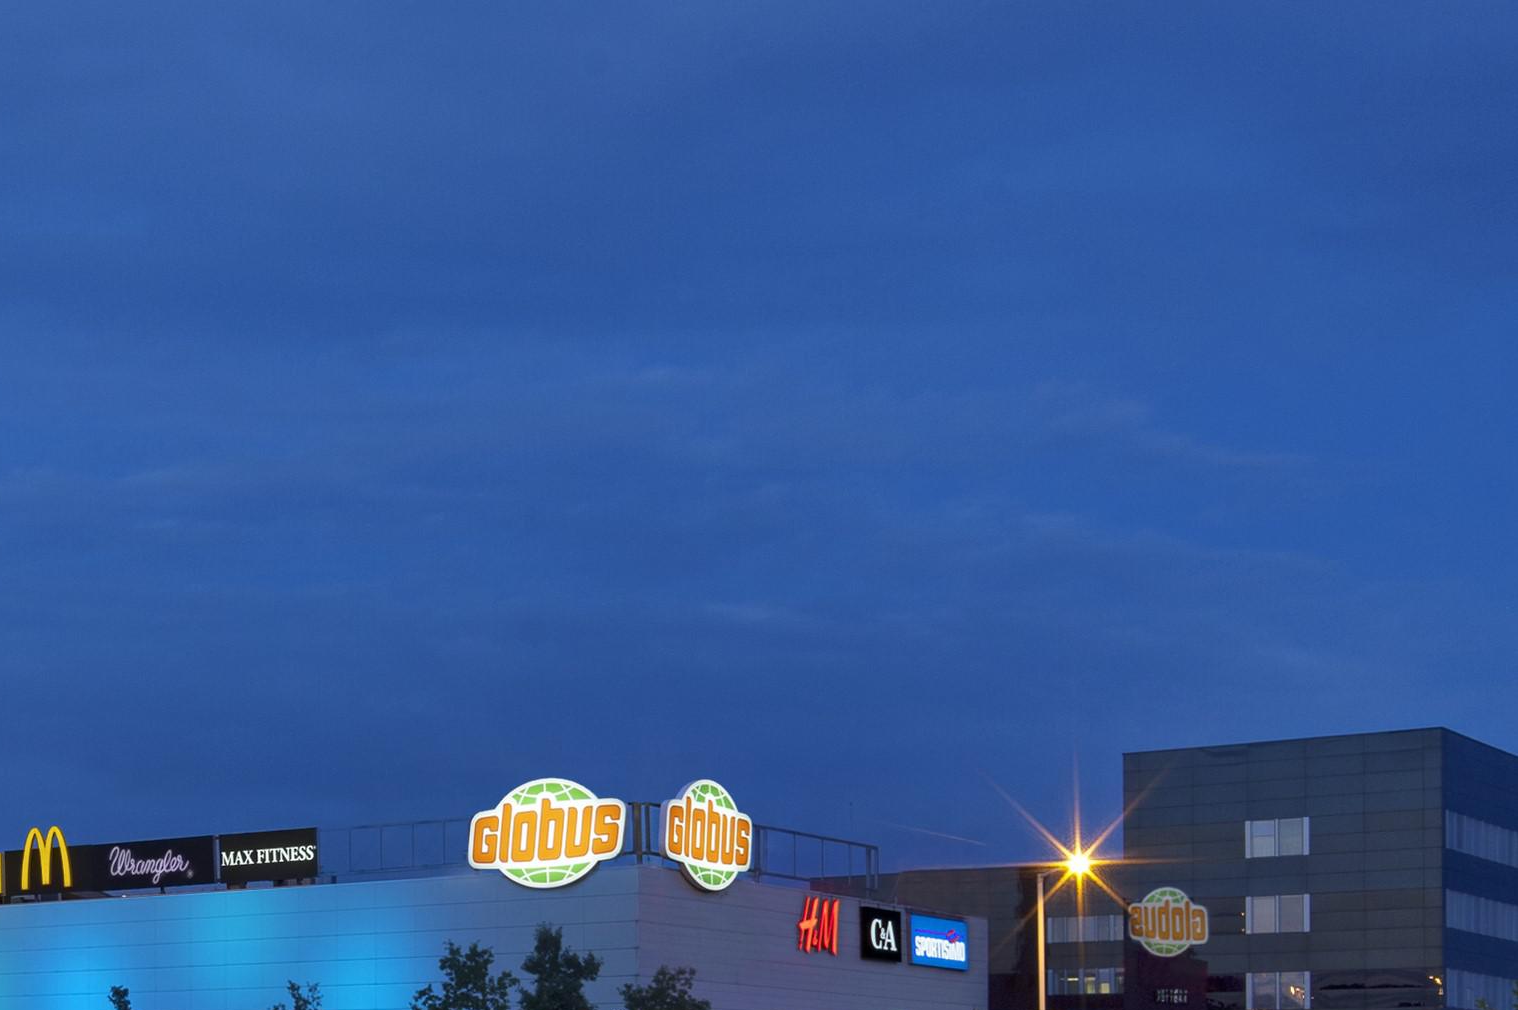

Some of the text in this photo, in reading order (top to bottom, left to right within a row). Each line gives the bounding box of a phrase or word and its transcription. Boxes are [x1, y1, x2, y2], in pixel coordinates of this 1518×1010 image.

[109, 846, 190, 884] Wrangler
[221, 846, 314, 866] MAX FITNESS
[798, 896, 840, 956] H&M
[870, 918, 897, 952] C&A
